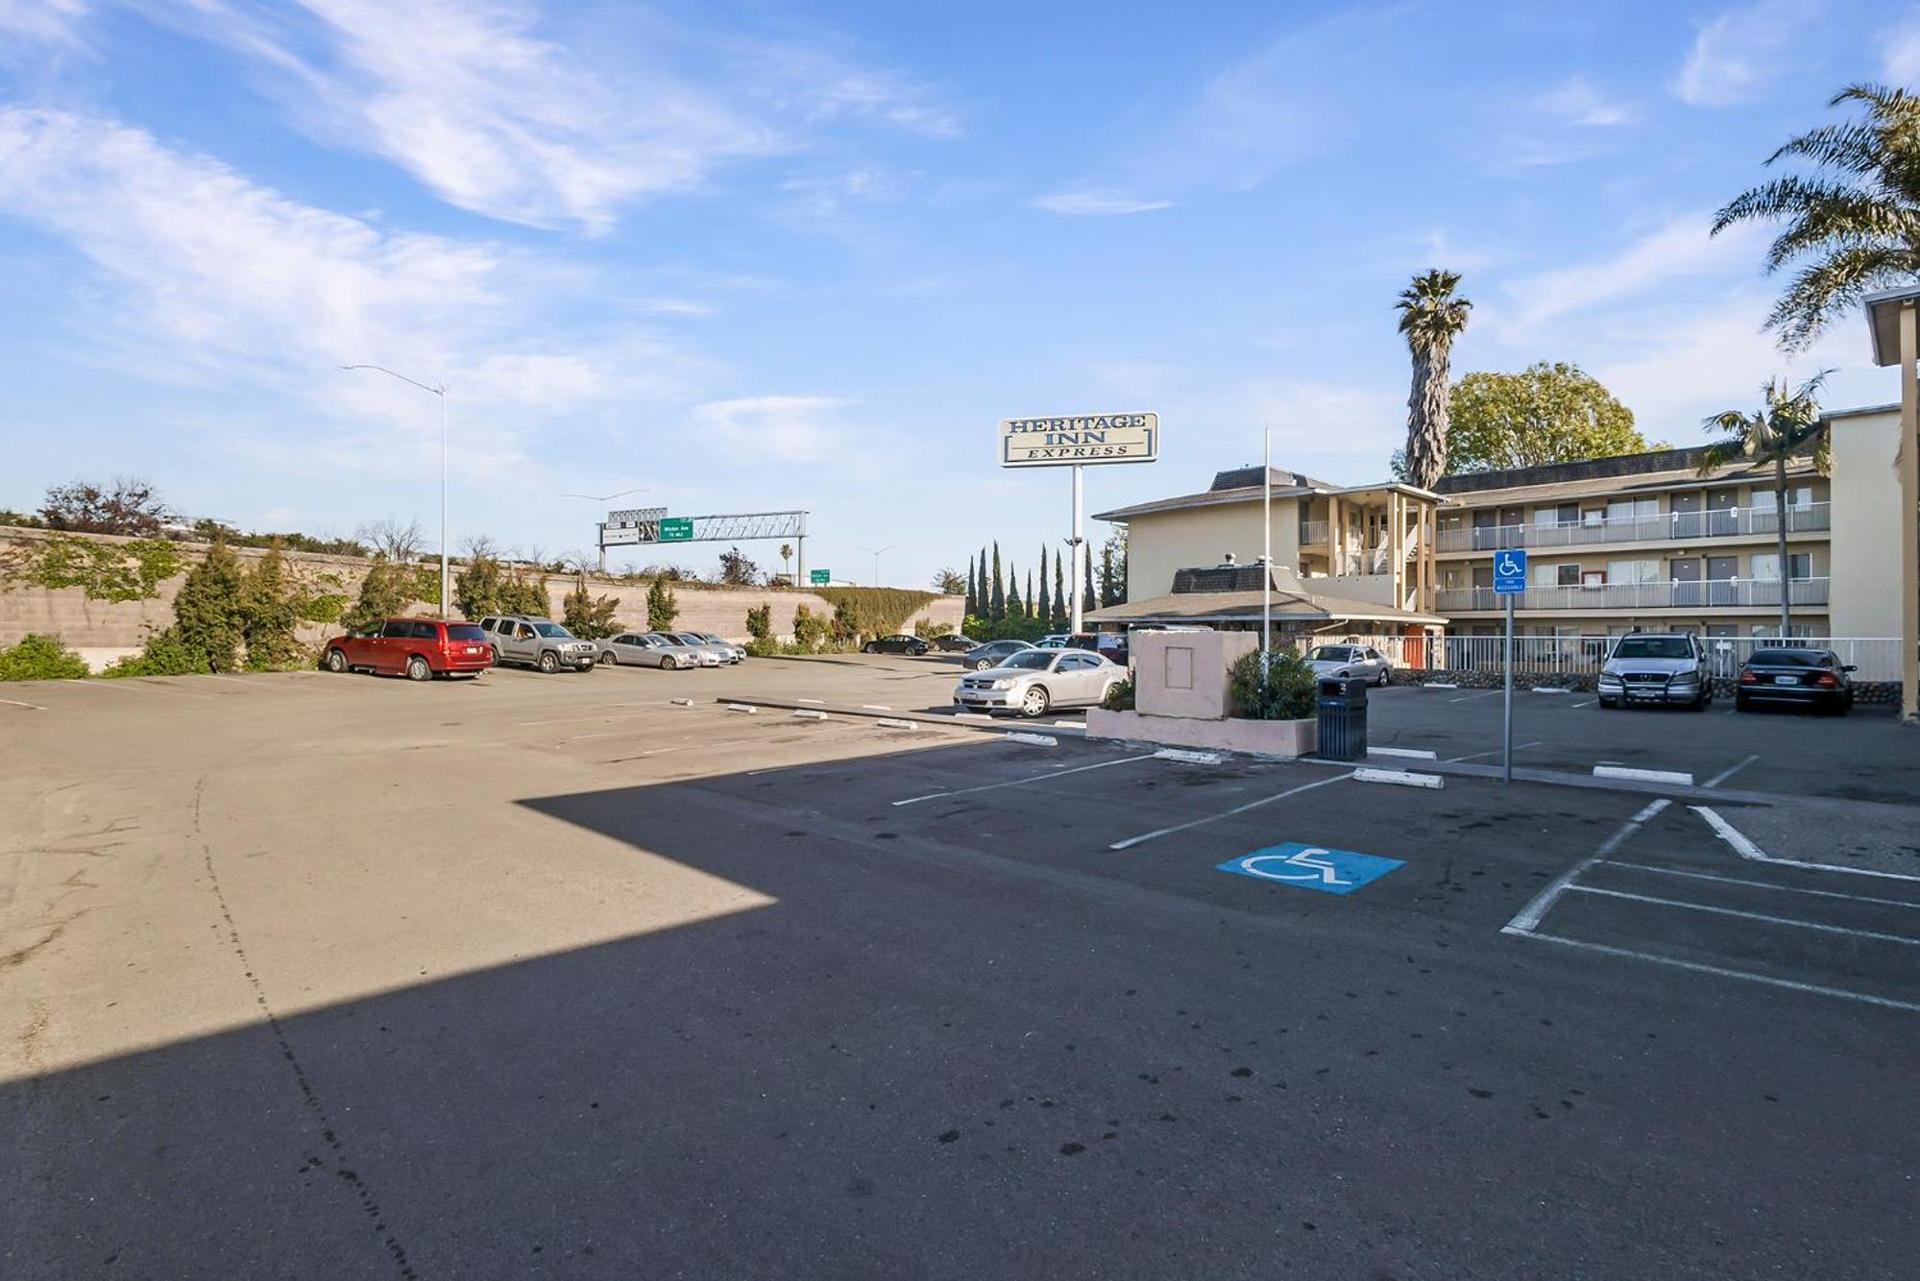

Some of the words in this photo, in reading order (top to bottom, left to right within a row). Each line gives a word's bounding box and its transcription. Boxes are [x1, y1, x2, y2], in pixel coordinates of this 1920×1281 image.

[1010, 415, 1145, 433] HERITAGE
[1044, 431, 1105, 445] INN
[1028, 446, 1128, 458] EXPRESS
